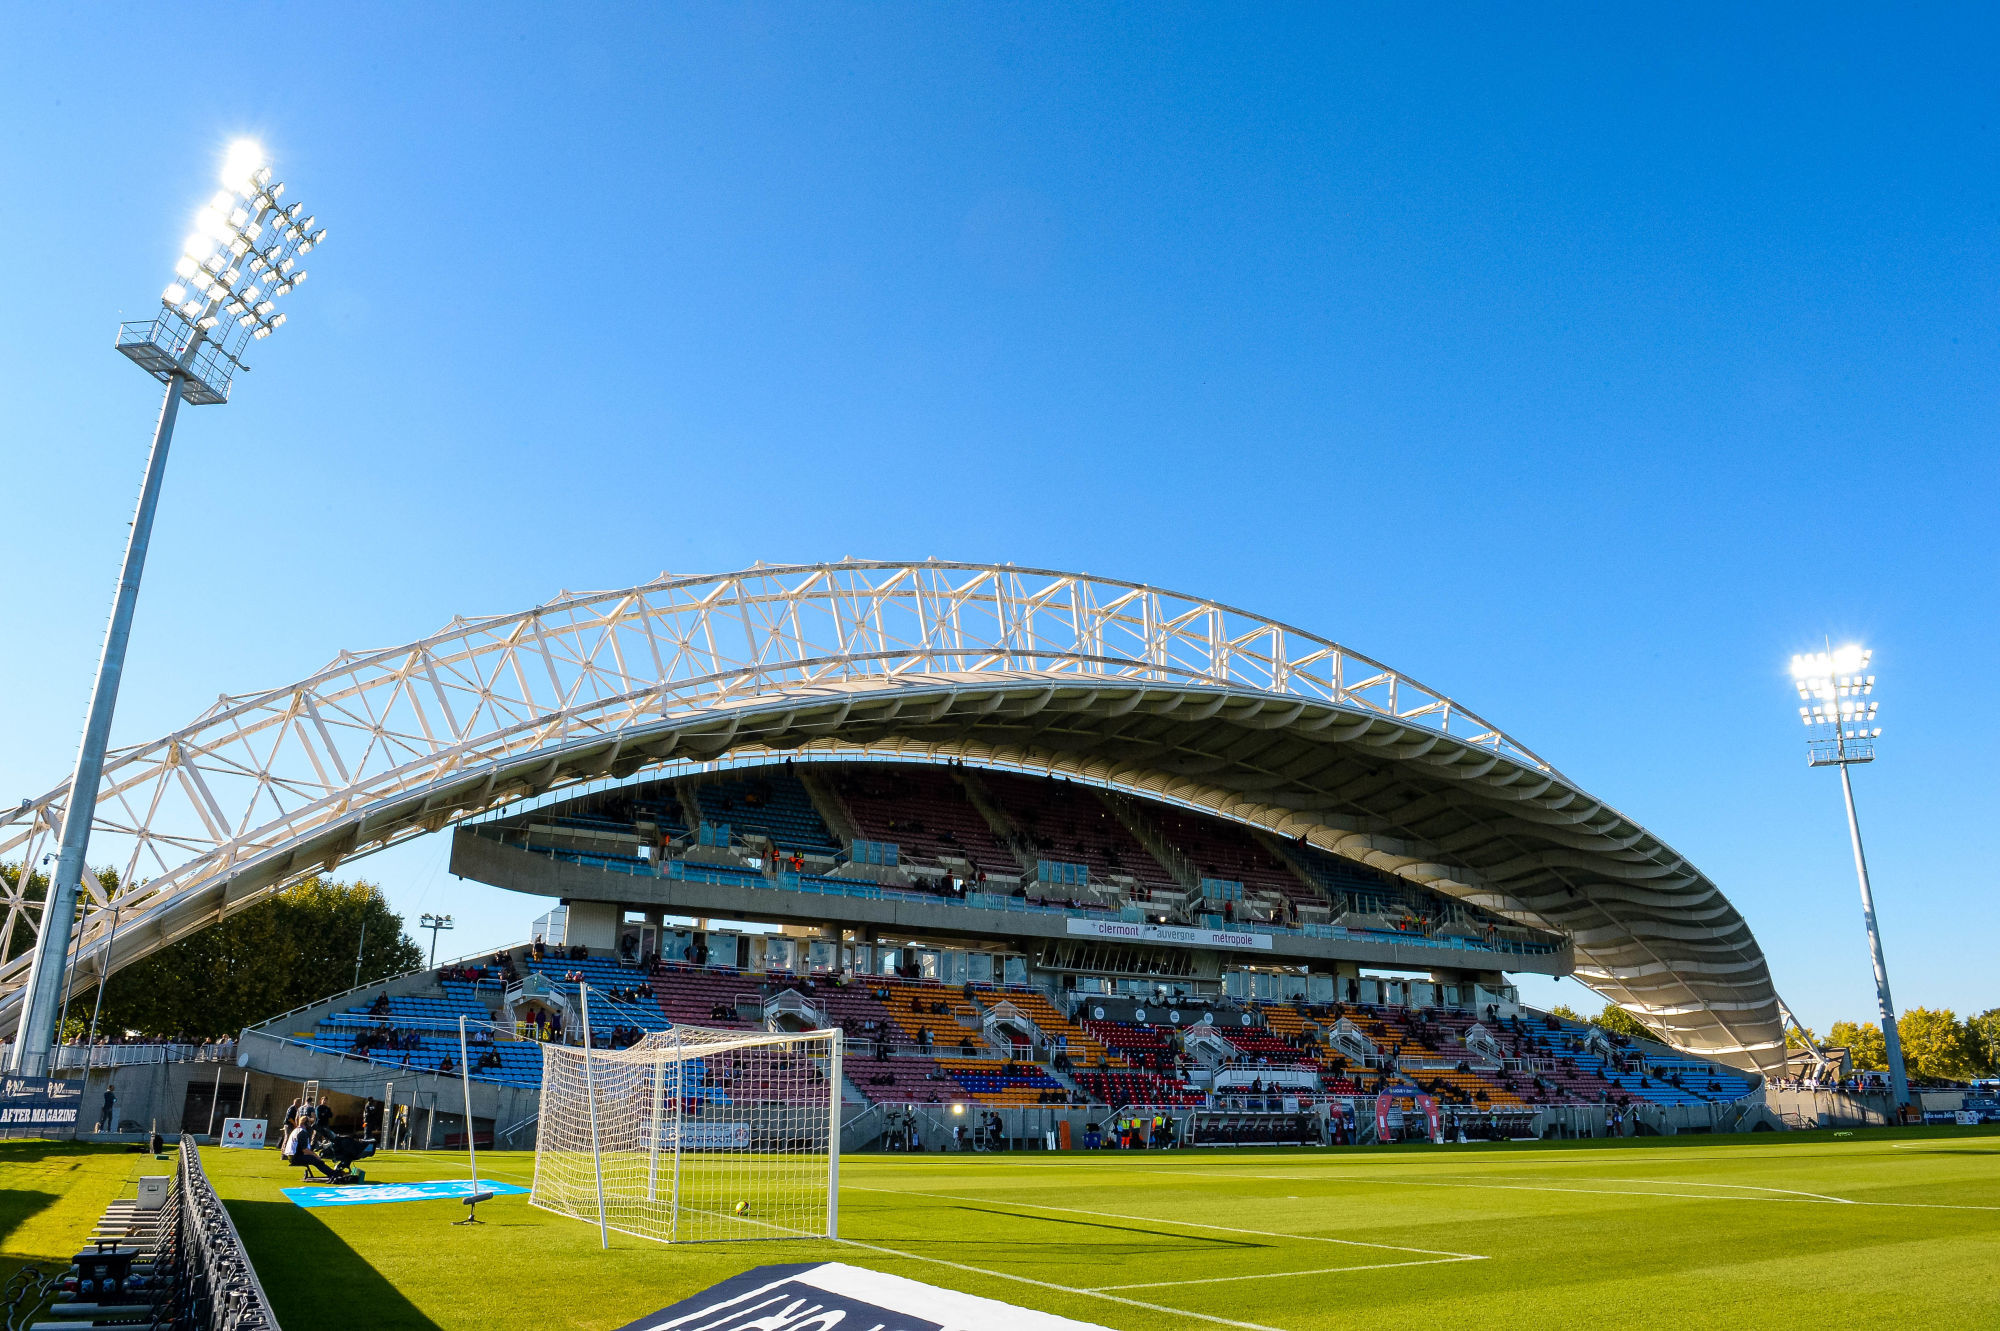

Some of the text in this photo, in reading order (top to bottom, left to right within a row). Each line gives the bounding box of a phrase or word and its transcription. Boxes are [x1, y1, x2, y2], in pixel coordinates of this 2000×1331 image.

[1098, 923, 1253, 946] clermont auvergne métropole
[0, 1108, 77, 1122] AFTER MAGAZINE
